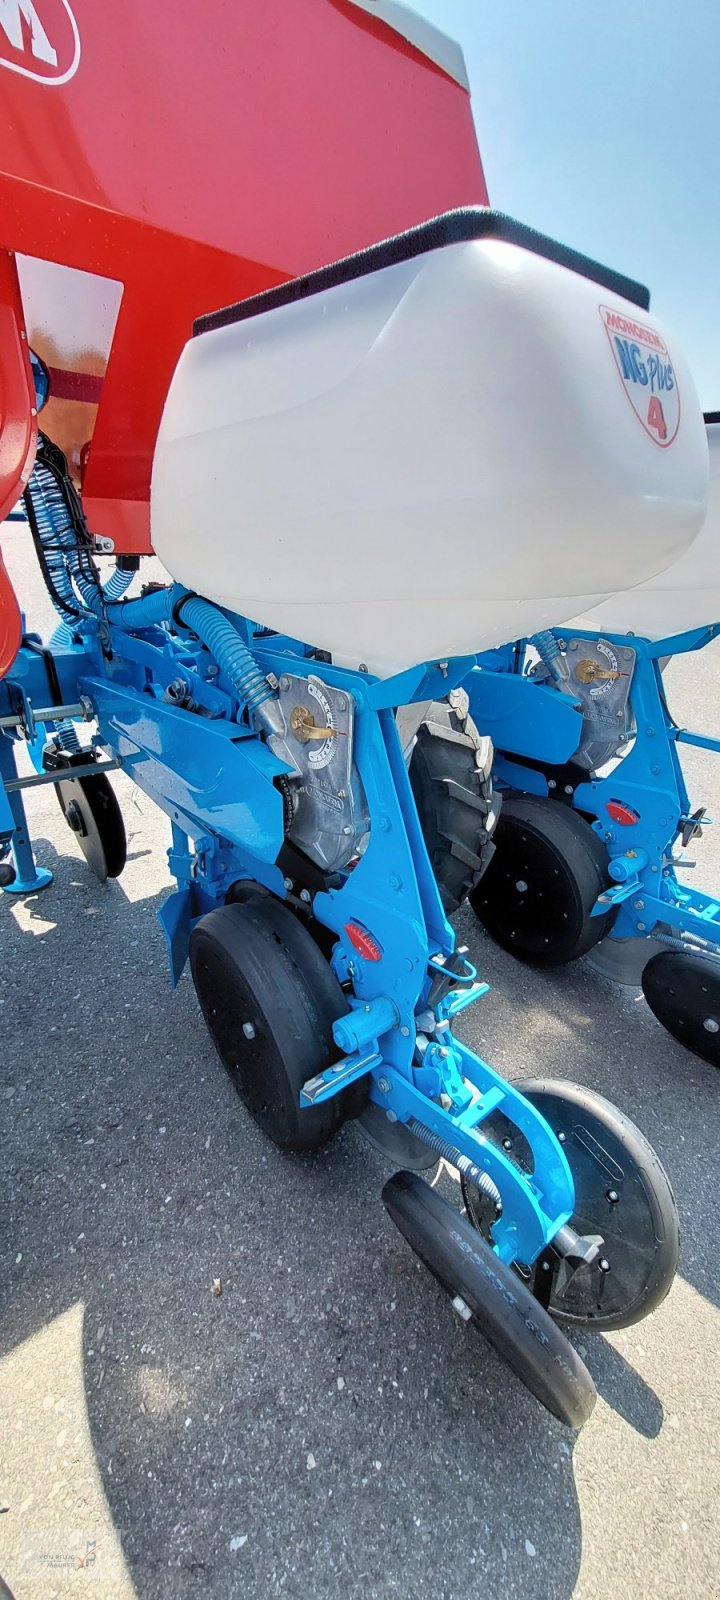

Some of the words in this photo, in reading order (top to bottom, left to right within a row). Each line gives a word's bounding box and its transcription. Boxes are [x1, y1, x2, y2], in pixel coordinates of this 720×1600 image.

[606, 311, 664, 350] MONOSEM
[614, 335, 649, 386] NG
[647, 395, 667, 439] 4
